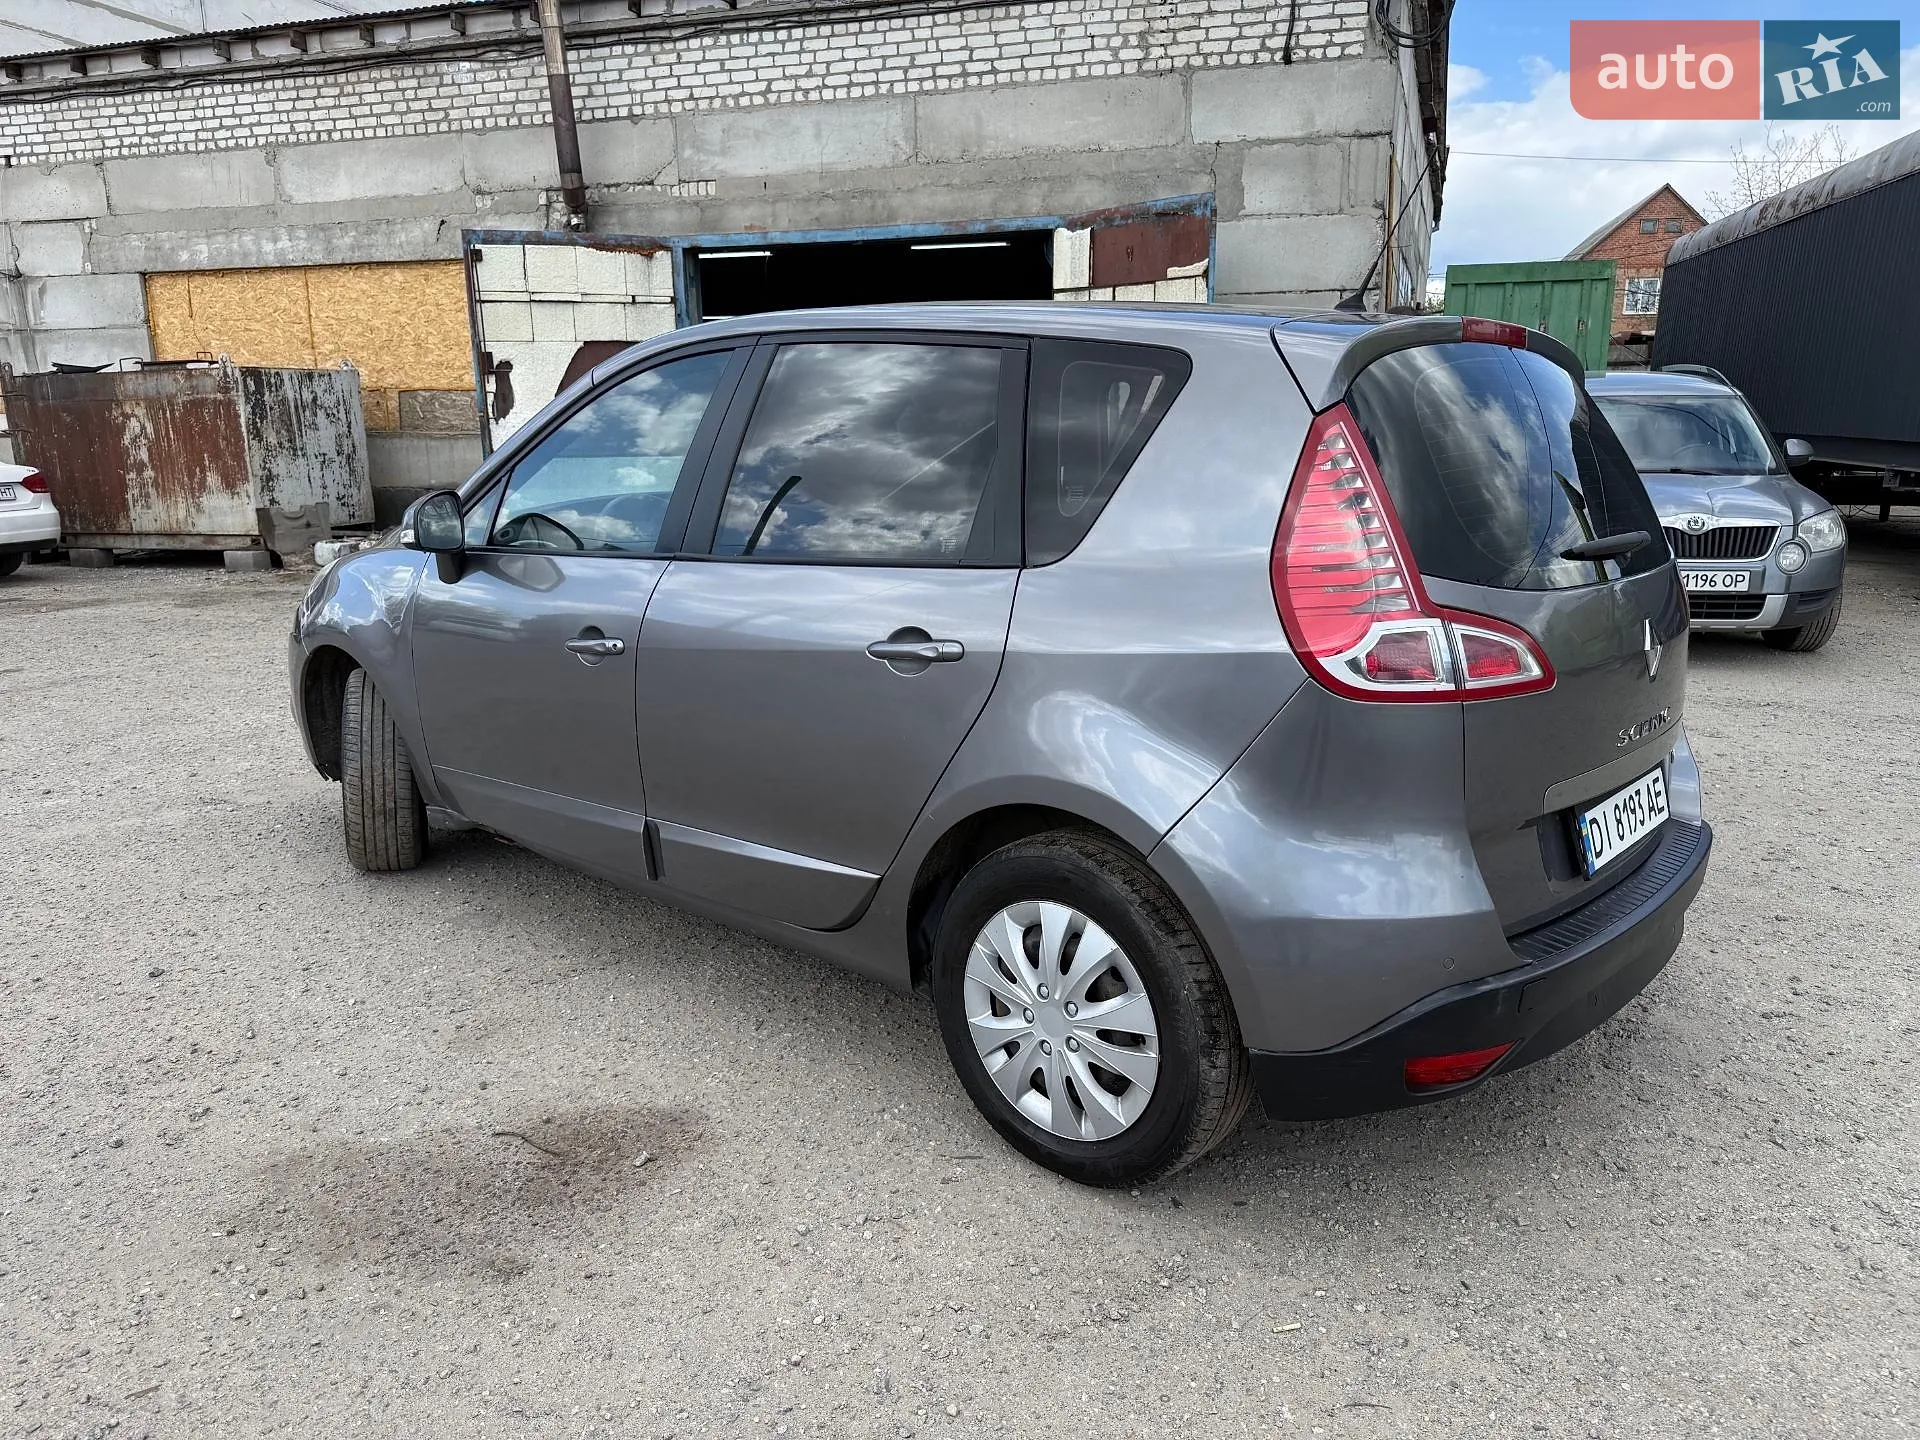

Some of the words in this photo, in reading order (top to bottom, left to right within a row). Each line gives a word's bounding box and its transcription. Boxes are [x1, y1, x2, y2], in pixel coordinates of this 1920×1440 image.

[1682, 573, 1718, 588] 1196
[1722, 573, 1746, 588] OP
[1588, 811, 1612, 860] DI
[1613, 788, 1645, 842] 8193
[1646, 776, 1665, 821] AE
